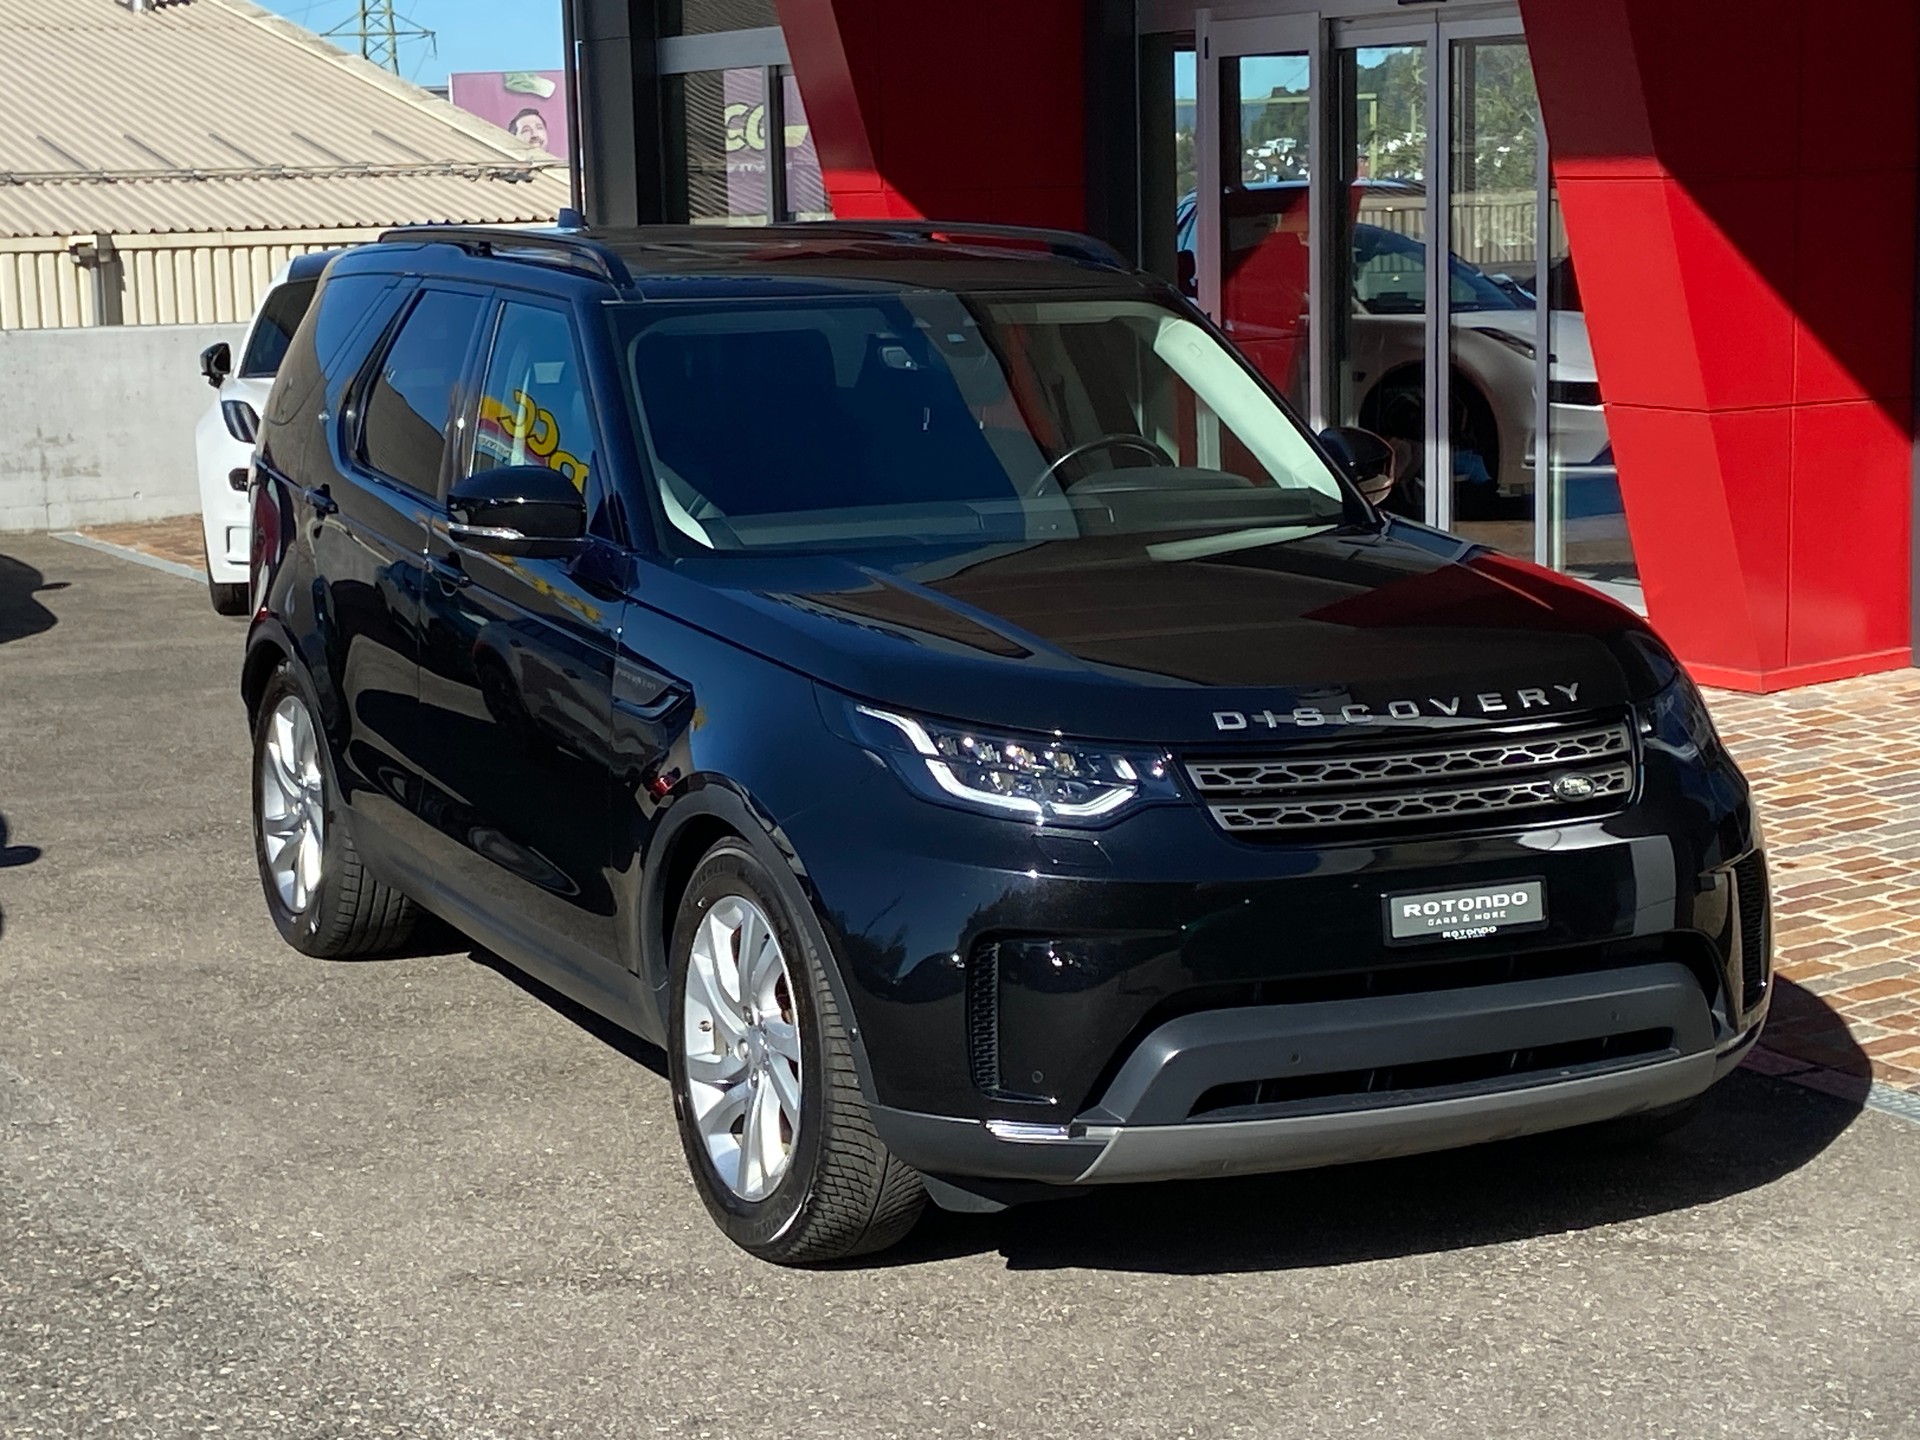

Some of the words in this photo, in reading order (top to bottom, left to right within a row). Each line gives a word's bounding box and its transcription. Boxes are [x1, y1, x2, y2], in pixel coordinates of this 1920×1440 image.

[1212, 682, 1580, 731] DISCOVERY
[1403, 891, 1528, 917] ROTONDO
[1427, 916, 1458, 927] CARS
[1462, 914, 1470, 922] &
[1474, 910, 1507, 920] MORE
[1442, 925, 1497, 938] ROTONDO
